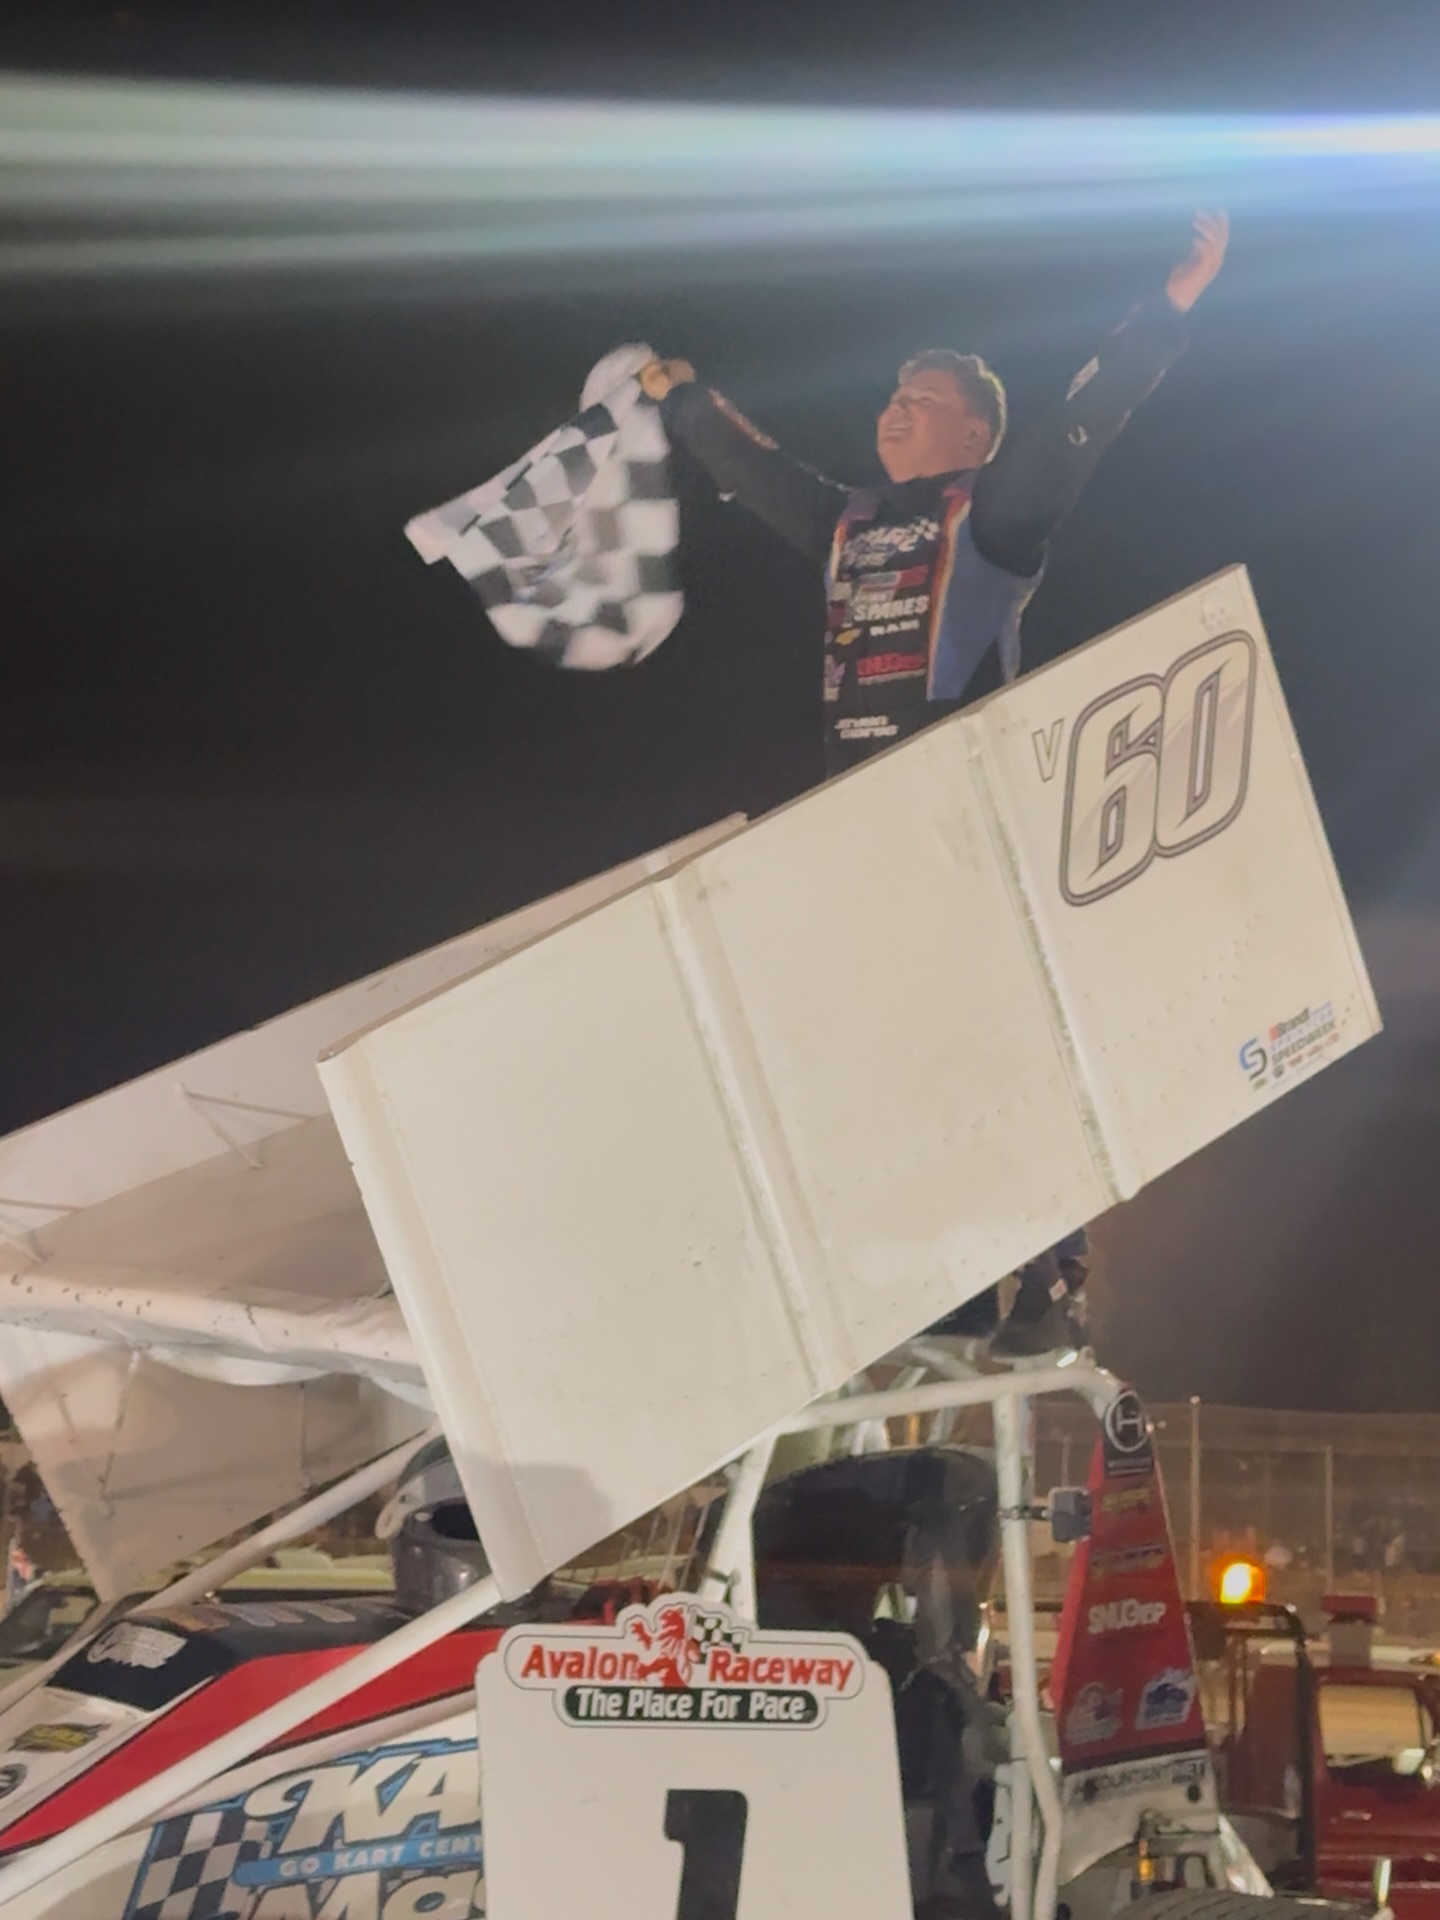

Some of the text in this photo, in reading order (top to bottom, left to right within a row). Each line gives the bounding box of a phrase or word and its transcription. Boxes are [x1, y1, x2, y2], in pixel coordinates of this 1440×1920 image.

[1031, 629, 1257, 907] V 60
[521, 1645, 854, 1691] Avalon Raceway
[576, 1688, 804, 1720] The Place For Pace
[280, 1858, 320, 1877] GO
[333, 1844, 406, 1870] KART
[664, 1789, 748, 1920] 1
